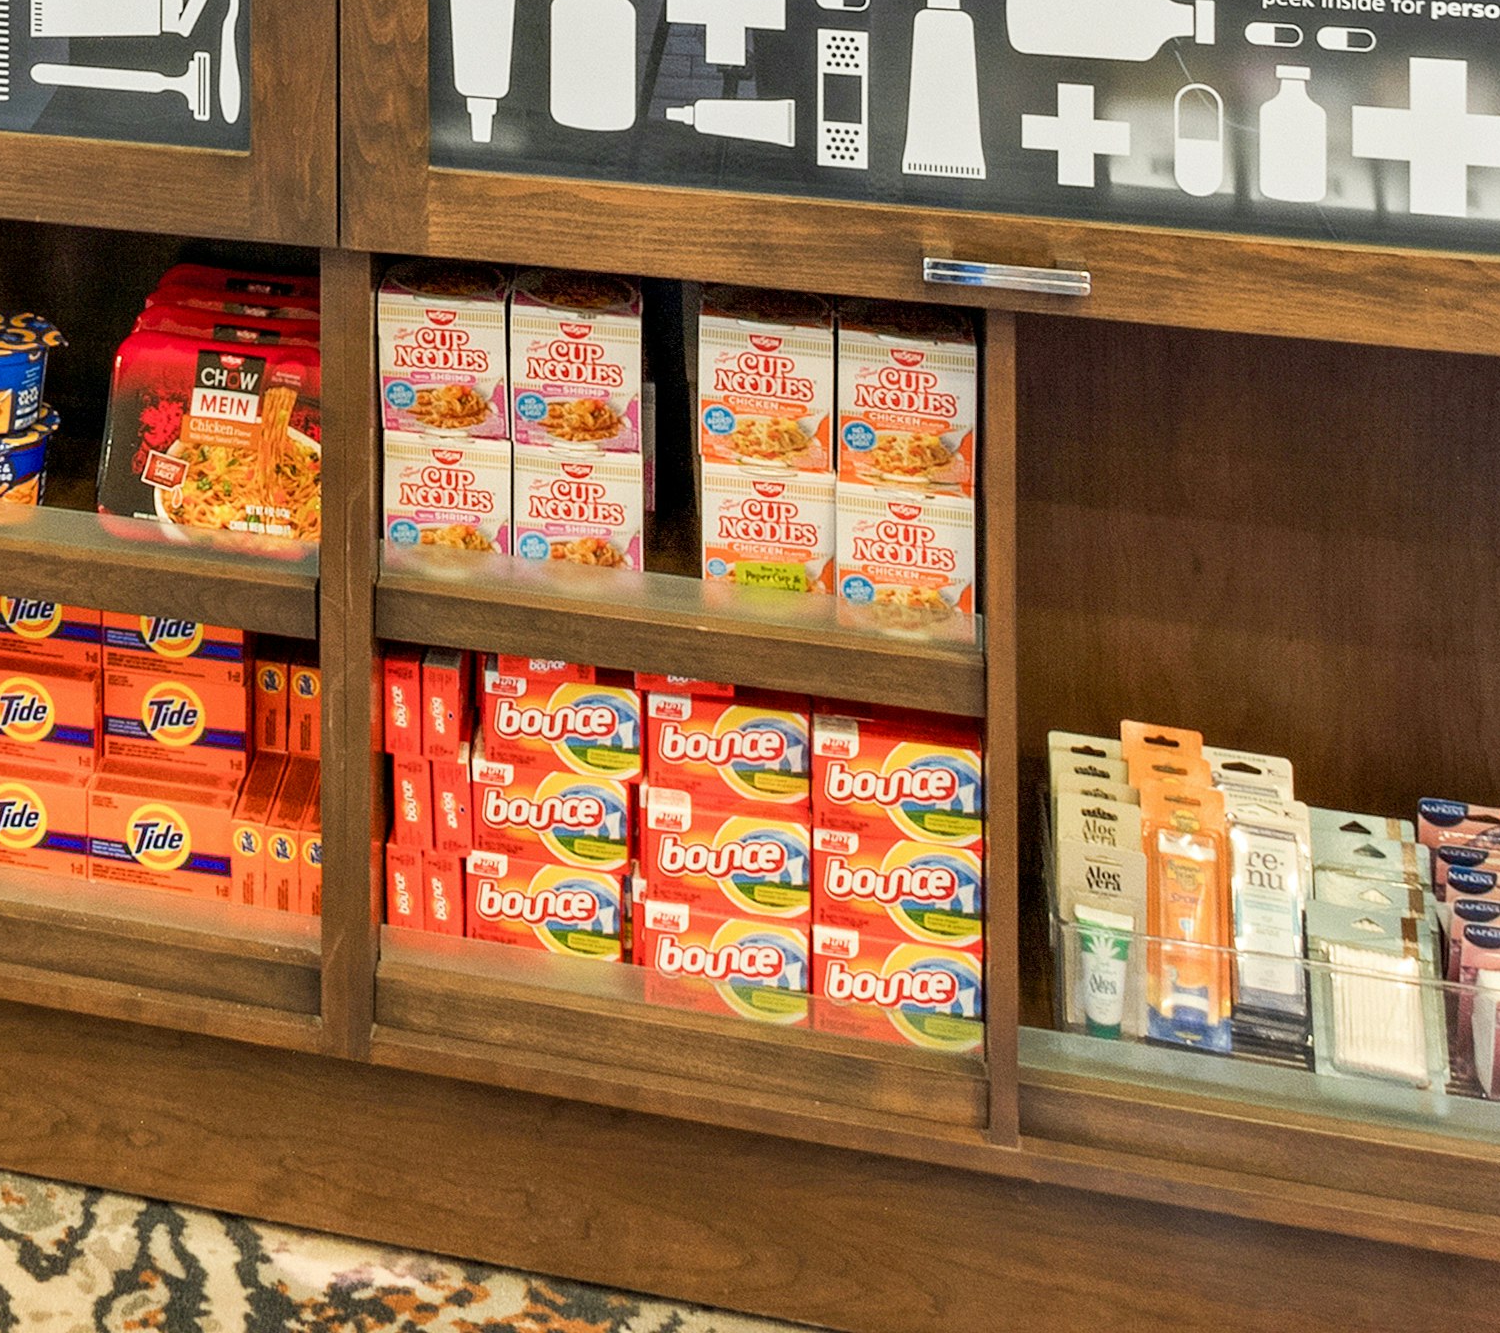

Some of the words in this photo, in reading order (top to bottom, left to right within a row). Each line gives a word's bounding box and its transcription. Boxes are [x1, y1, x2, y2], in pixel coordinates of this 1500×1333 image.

[416, 329, 469, 351] CUP
[395, 346, 490, 372] NOODLES
[200, 367, 258, 391] CHOW
[431, 373, 474, 384] SHRIMP
[880, 369, 936, 394] CUP
[200, 394, 252, 417] MEIN
[856, 384, 958, 419] NOODLES
[189, 418, 233, 434] Chicken
[870, 412, 918, 428] CHICKEN
[496, 699, 617, 740] bounce
[133, 822, 183, 854] Tide
[1085, 864, 1121, 882] Aloe
[825, 963, 957, 1006] bounce
